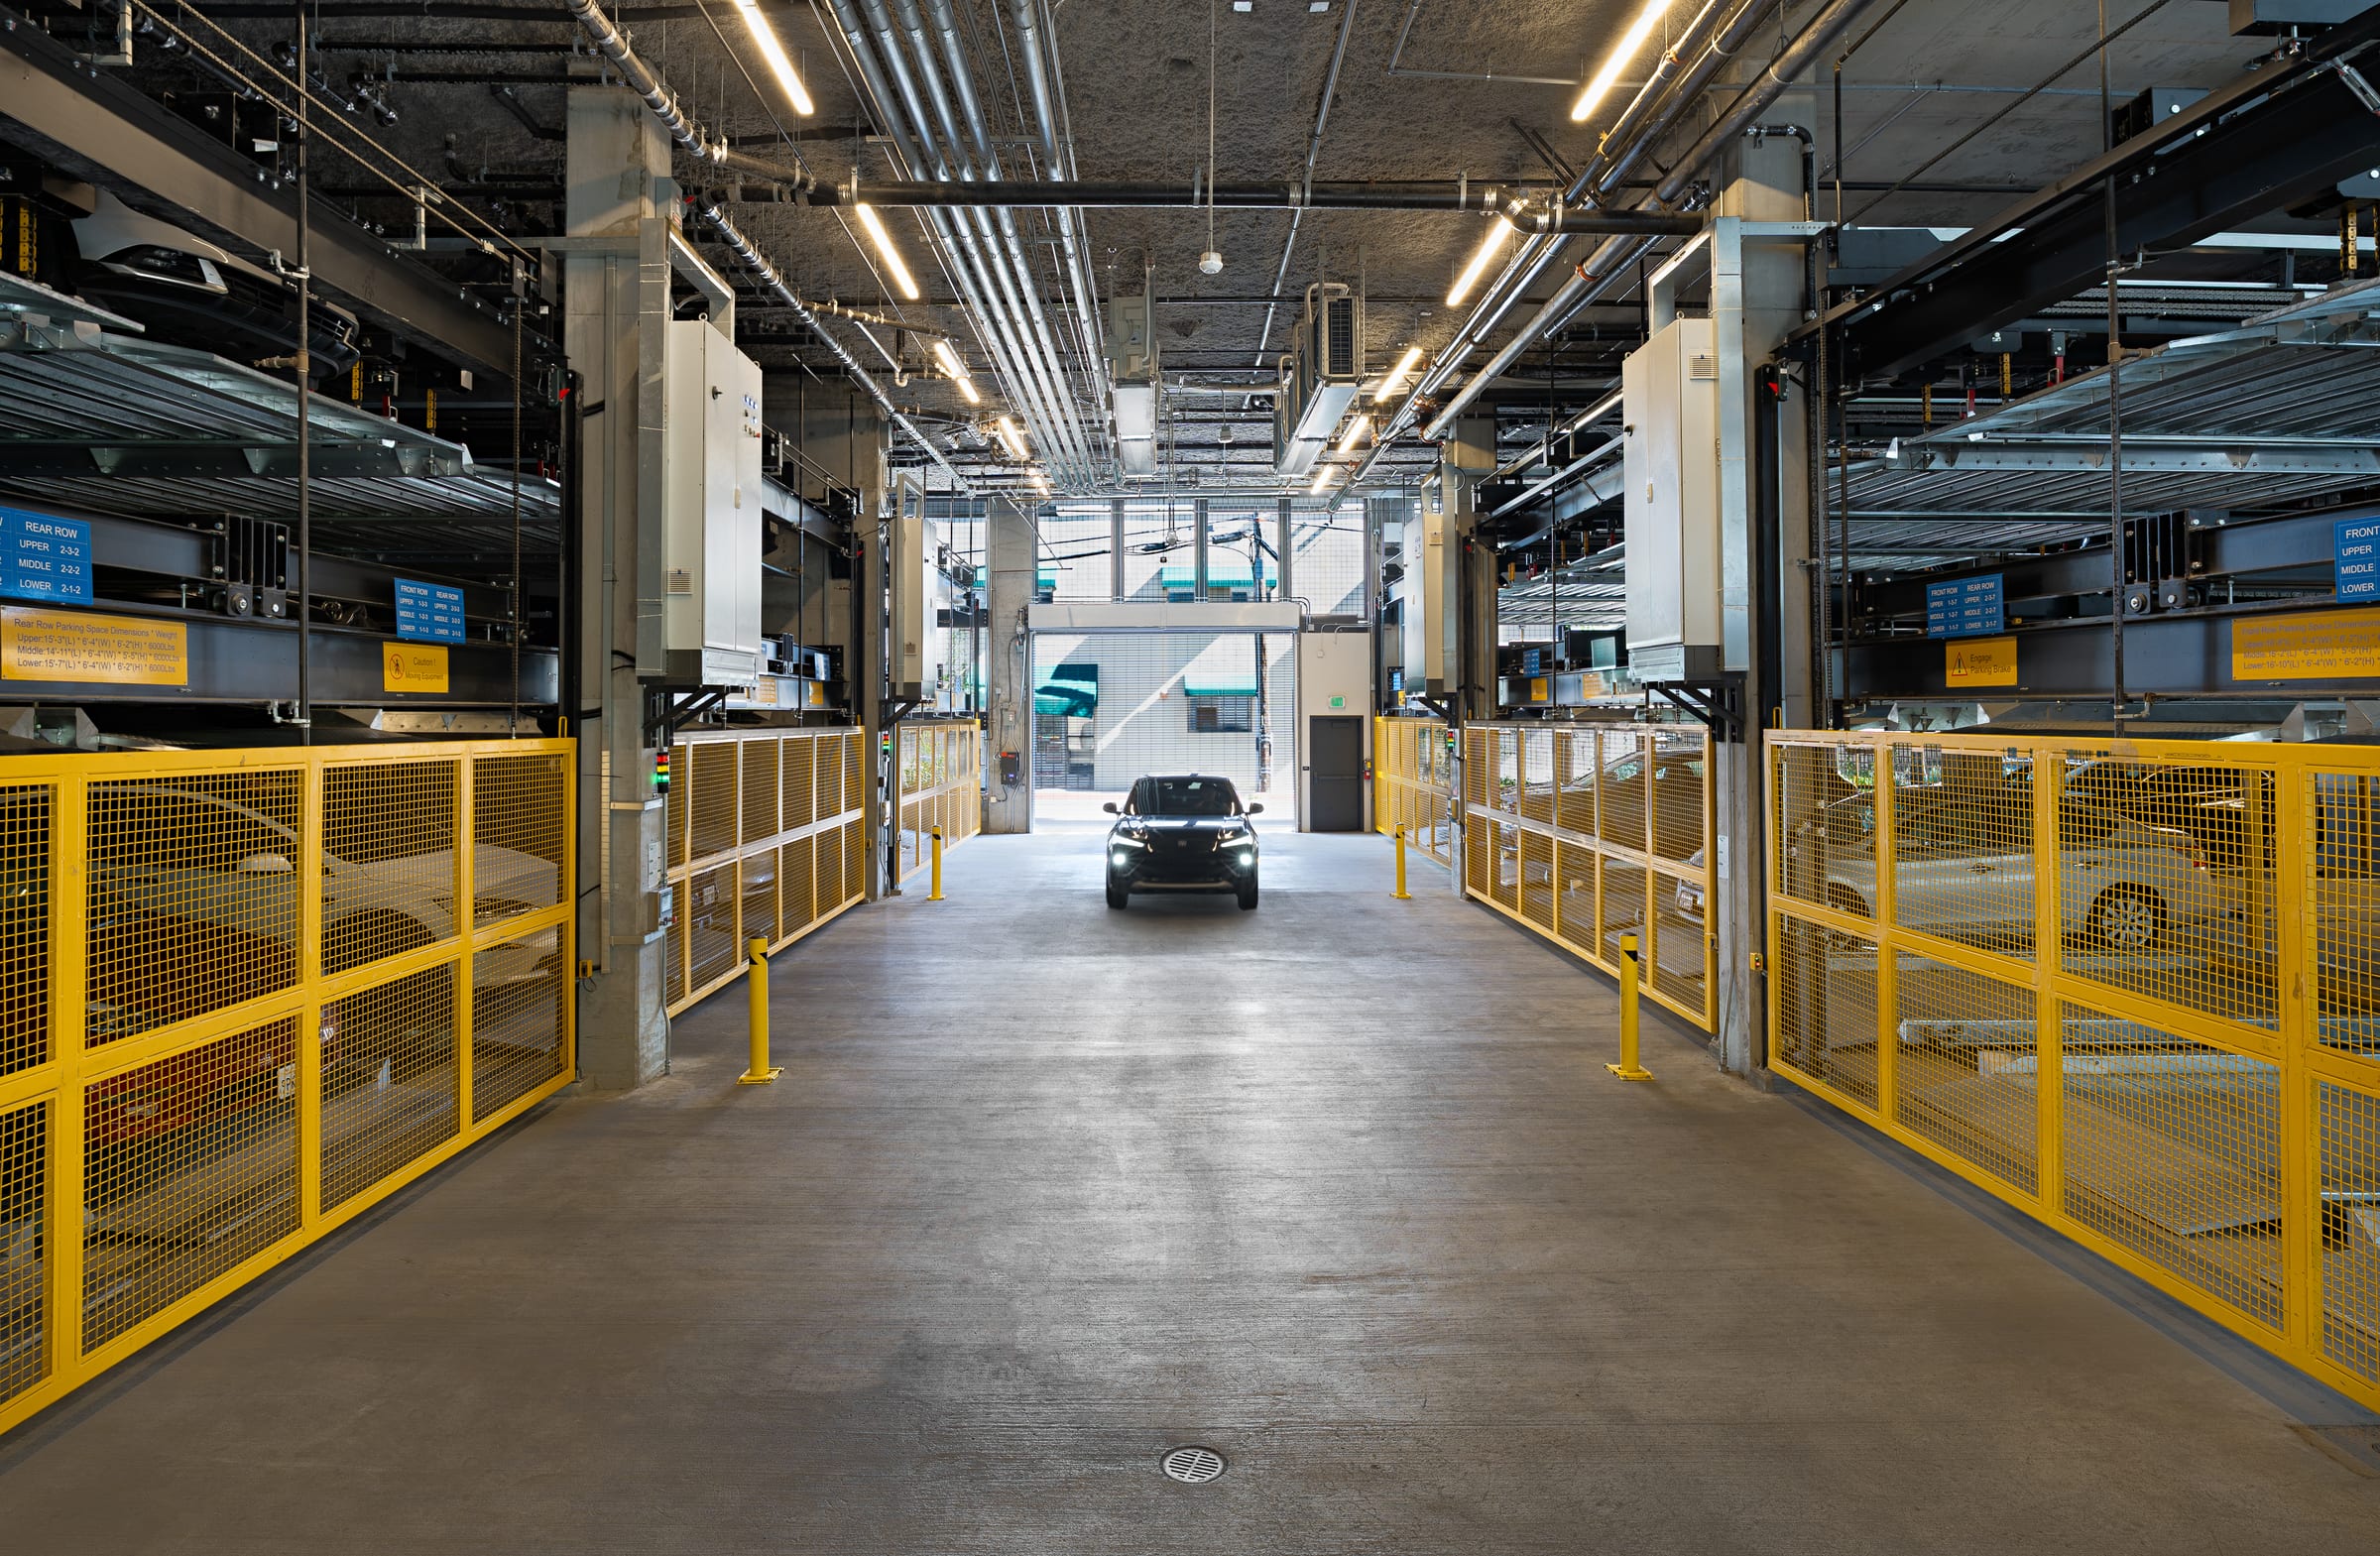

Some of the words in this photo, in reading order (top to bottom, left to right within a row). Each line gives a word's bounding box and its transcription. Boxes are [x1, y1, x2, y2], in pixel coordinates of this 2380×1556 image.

[26, 522, 52, 535] REAR
[56, 527, 77, 539] ROW
[2346, 526, 2380, 539] FRONT
[20, 539, 50, 551] UPPER
[60, 545, 79, 555] 2-3-2
[2342, 545, 2372, 555] UPPER
[19, 558, 51, 570] MIDDLE
[60, 564, 79, 574] 2-2-2
[2341, 563, 2374, 574] MIDDLE
[20, 579, 52, 590] LOWER
[61, 584, 80, 594] 2-1-2
[2342, 583, 2374, 593] LOWER
[14, 619, 34, 628] Rear
[56, 622, 83, 633] Parking
[86, 625, 108, 634] Space
[111, 627, 149, 637] Dimensions
[156, 631, 177, 640] Weight
[1970, 655, 1991, 663] Engage
[1970, 666, 1991, 675] Parking
[1993, 664, 2011, 673] Brake
